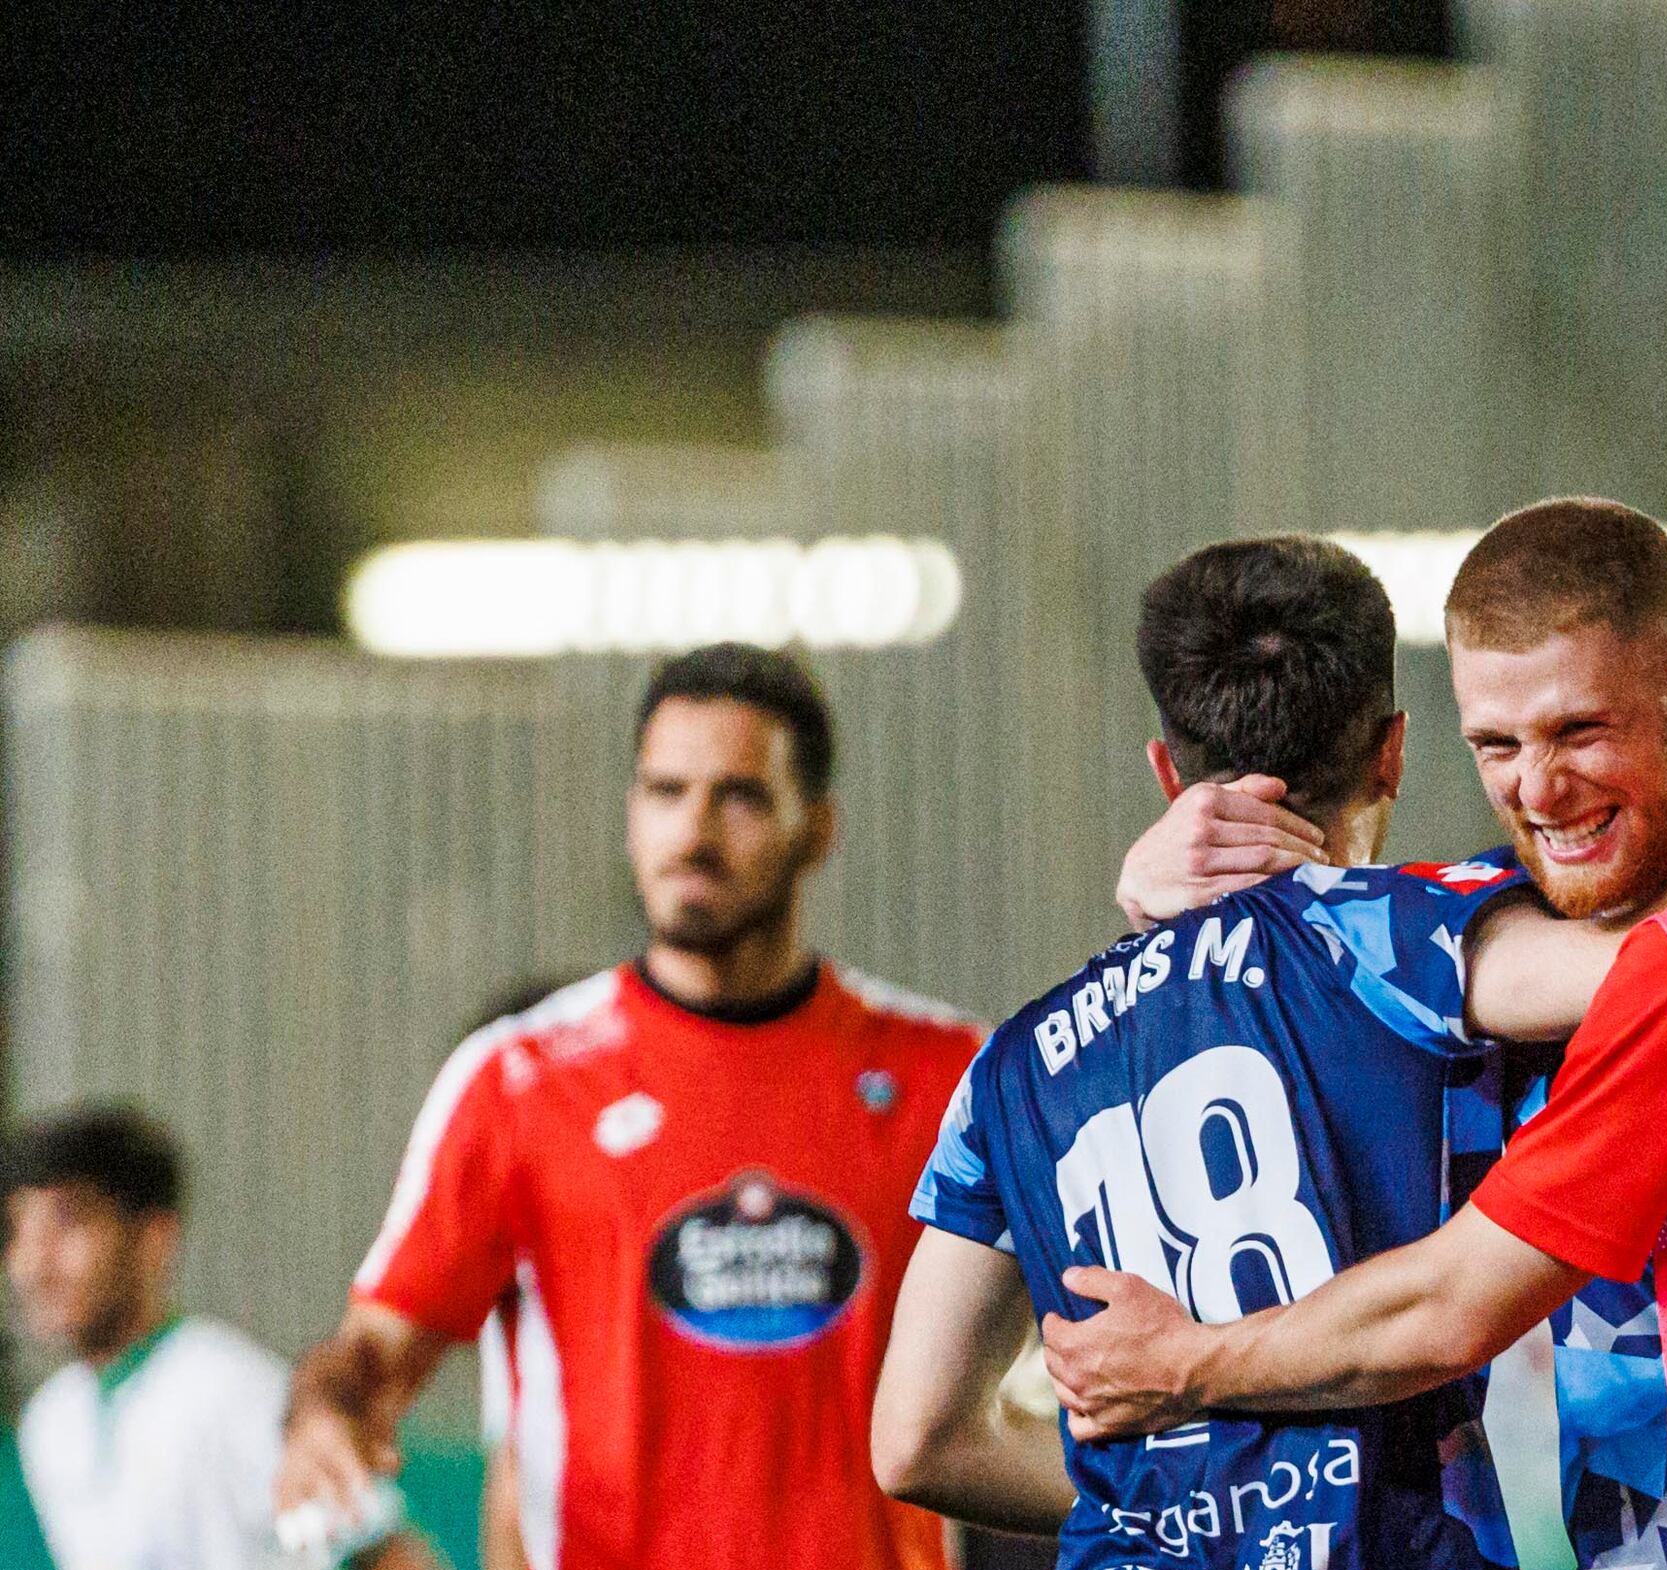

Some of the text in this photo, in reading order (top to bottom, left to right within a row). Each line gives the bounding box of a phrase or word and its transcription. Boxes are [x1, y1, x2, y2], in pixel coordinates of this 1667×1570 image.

[1034, 929, 1175, 1076] BRAIS
[1188, 916, 1265, 989] M.
[1055, 1045, 1337, 1330] 18
